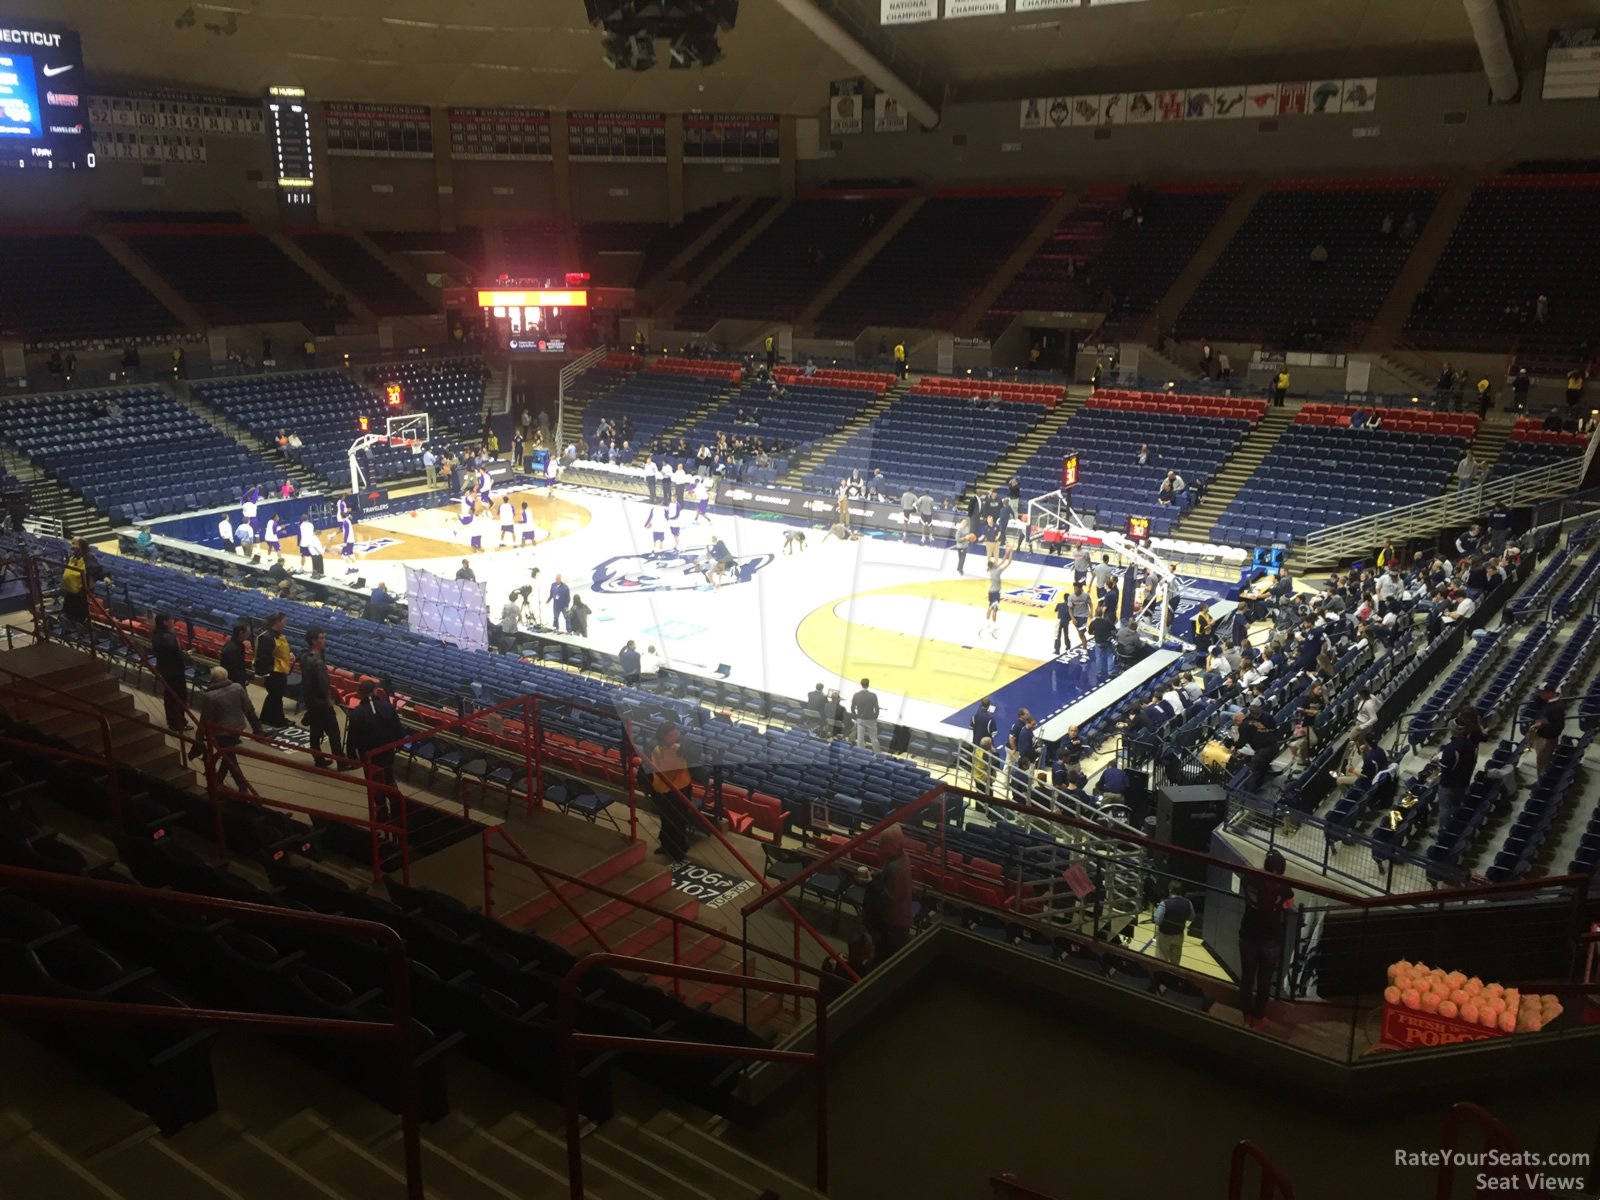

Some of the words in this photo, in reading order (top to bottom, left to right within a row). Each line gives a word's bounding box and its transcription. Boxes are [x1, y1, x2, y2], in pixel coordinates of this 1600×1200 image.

[889, 1, 928, 10] NATIONAL
[951, 4, 1000, 14] CHAMPIONS
[886, 10, 932, 21] CHAMPIONS
[164, 119, 177, 128] 13
[185, 119, 199, 128] 42
[87, 153, 96, 168] 0
[363, 504, 389, 514] TRAVELERS
[279, 726, 310, 738] 107
[681, 864, 723, 885] 106
[675, 880, 721, 899] 107
[1397, 1013, 1447, 1033] FRESH
